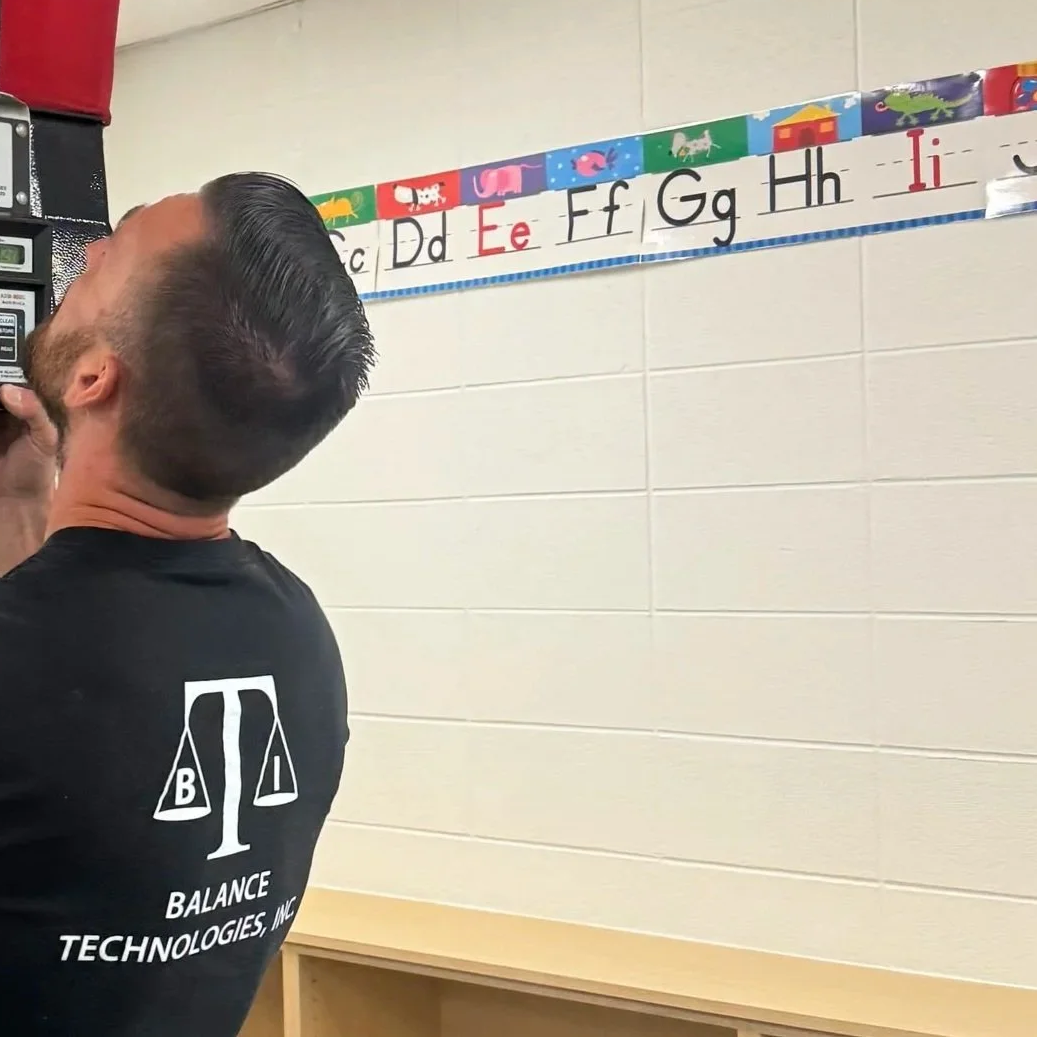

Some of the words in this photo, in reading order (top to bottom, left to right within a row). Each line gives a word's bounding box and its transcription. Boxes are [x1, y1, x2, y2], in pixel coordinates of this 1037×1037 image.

[392, 210, 447, 269] Dd
[478, 201, 531, 257] Ee
[567, 179, 630, 242] Ff
[657, 168, 736, 247] Gg
[769, 146, 841, 212] Hh
[906, 128, 941, 193] Ii
[174, 767, 196, 806] B
[165, 870, 271, 919] BALANCE
[59, 912, 267, 963] TECHNOLOGIES,
